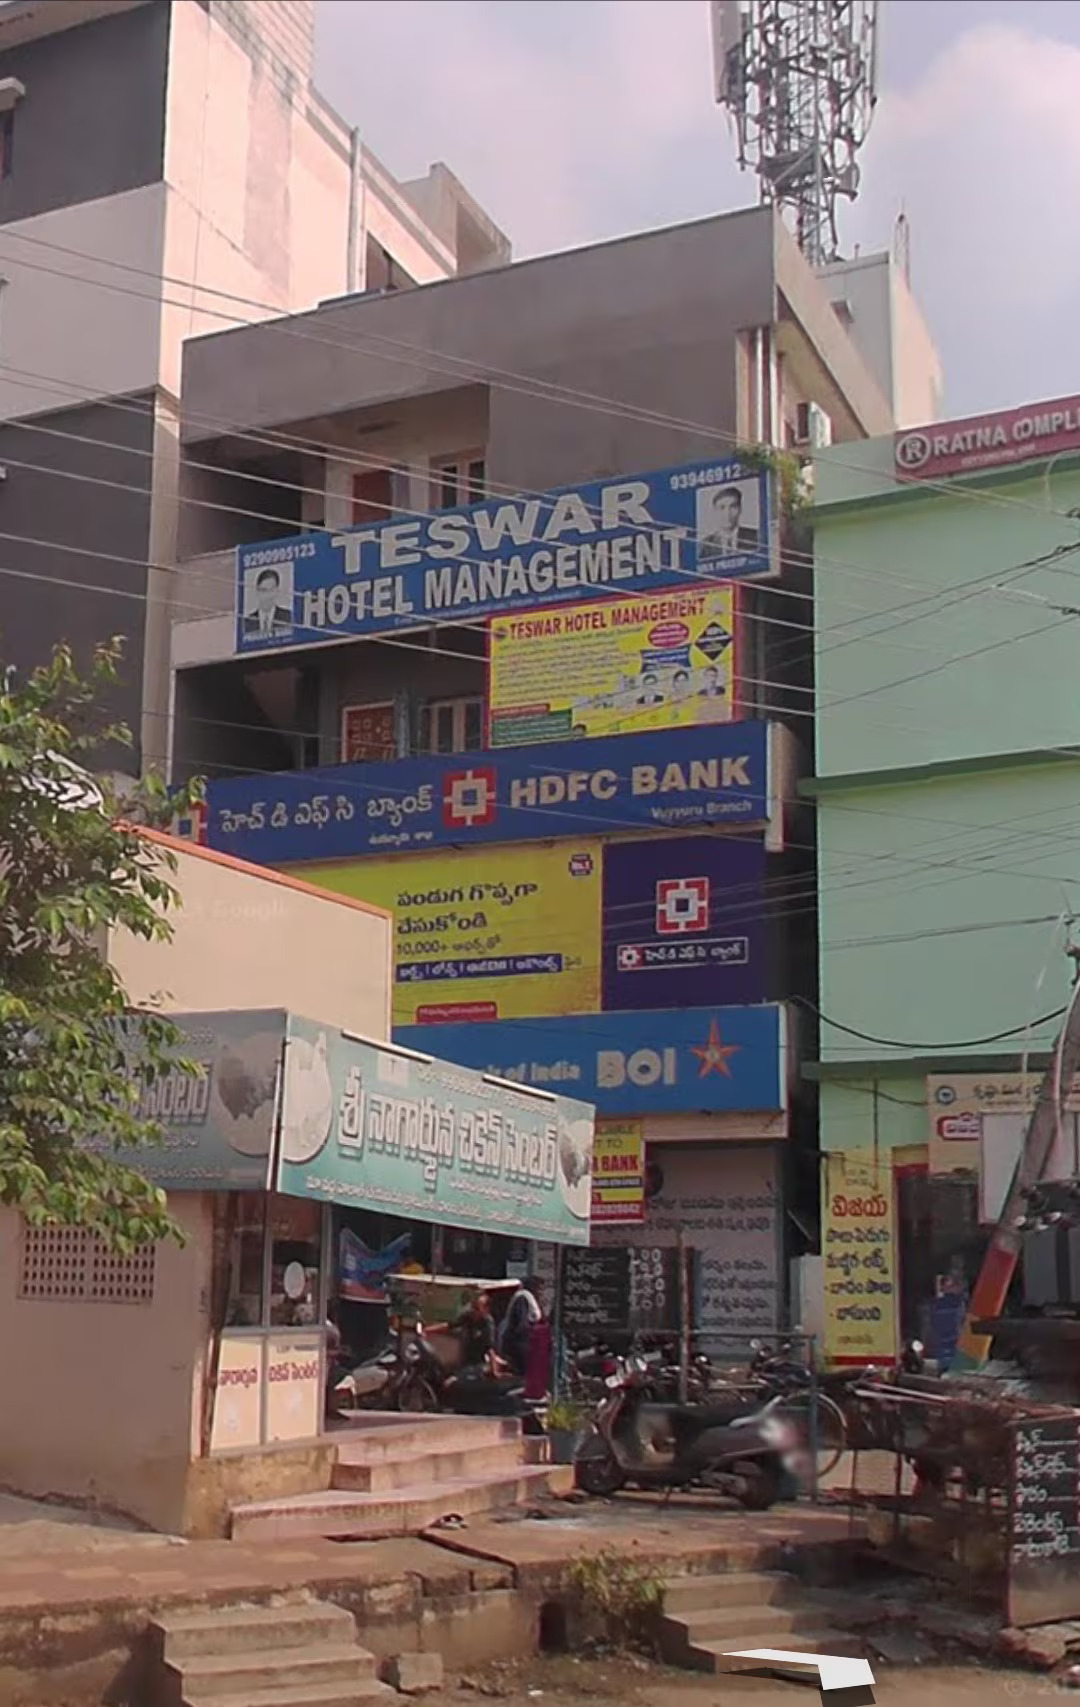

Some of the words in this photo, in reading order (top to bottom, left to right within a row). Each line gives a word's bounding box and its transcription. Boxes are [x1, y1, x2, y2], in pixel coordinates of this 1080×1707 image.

[670, 464, 758, 490] 93946912
[332, 482, 654, 575] TESWAR
[302, 579, 414, 629] HOTEL
[425, 526, 688, 609] MANAGEMENT
[510, 621, 562, 640] TESWAR
[565, 611, 607, 630] HOTEL
[611, 598, 706, 625] MANAGEMENT
[510, 769, 618, 808] HDFC
[631, 755, 752, 795] BANK
[219, 801, 265, 833] హెచ్
[270, 804, 289, 827] డి
[294, 795, 331, 830] ఎఫ్
[335, 795, 355, 820] సి
[366, 785, 434, 827] బ్యాంక్
[706, 799, 753, 815] Branch
[531, 1059, 581, 1081] India
[597, 1047, 676, 1089] BOI
[602, 1154, 639, 1172] BANK
[832, 1194, 888, 1218] విజయ
